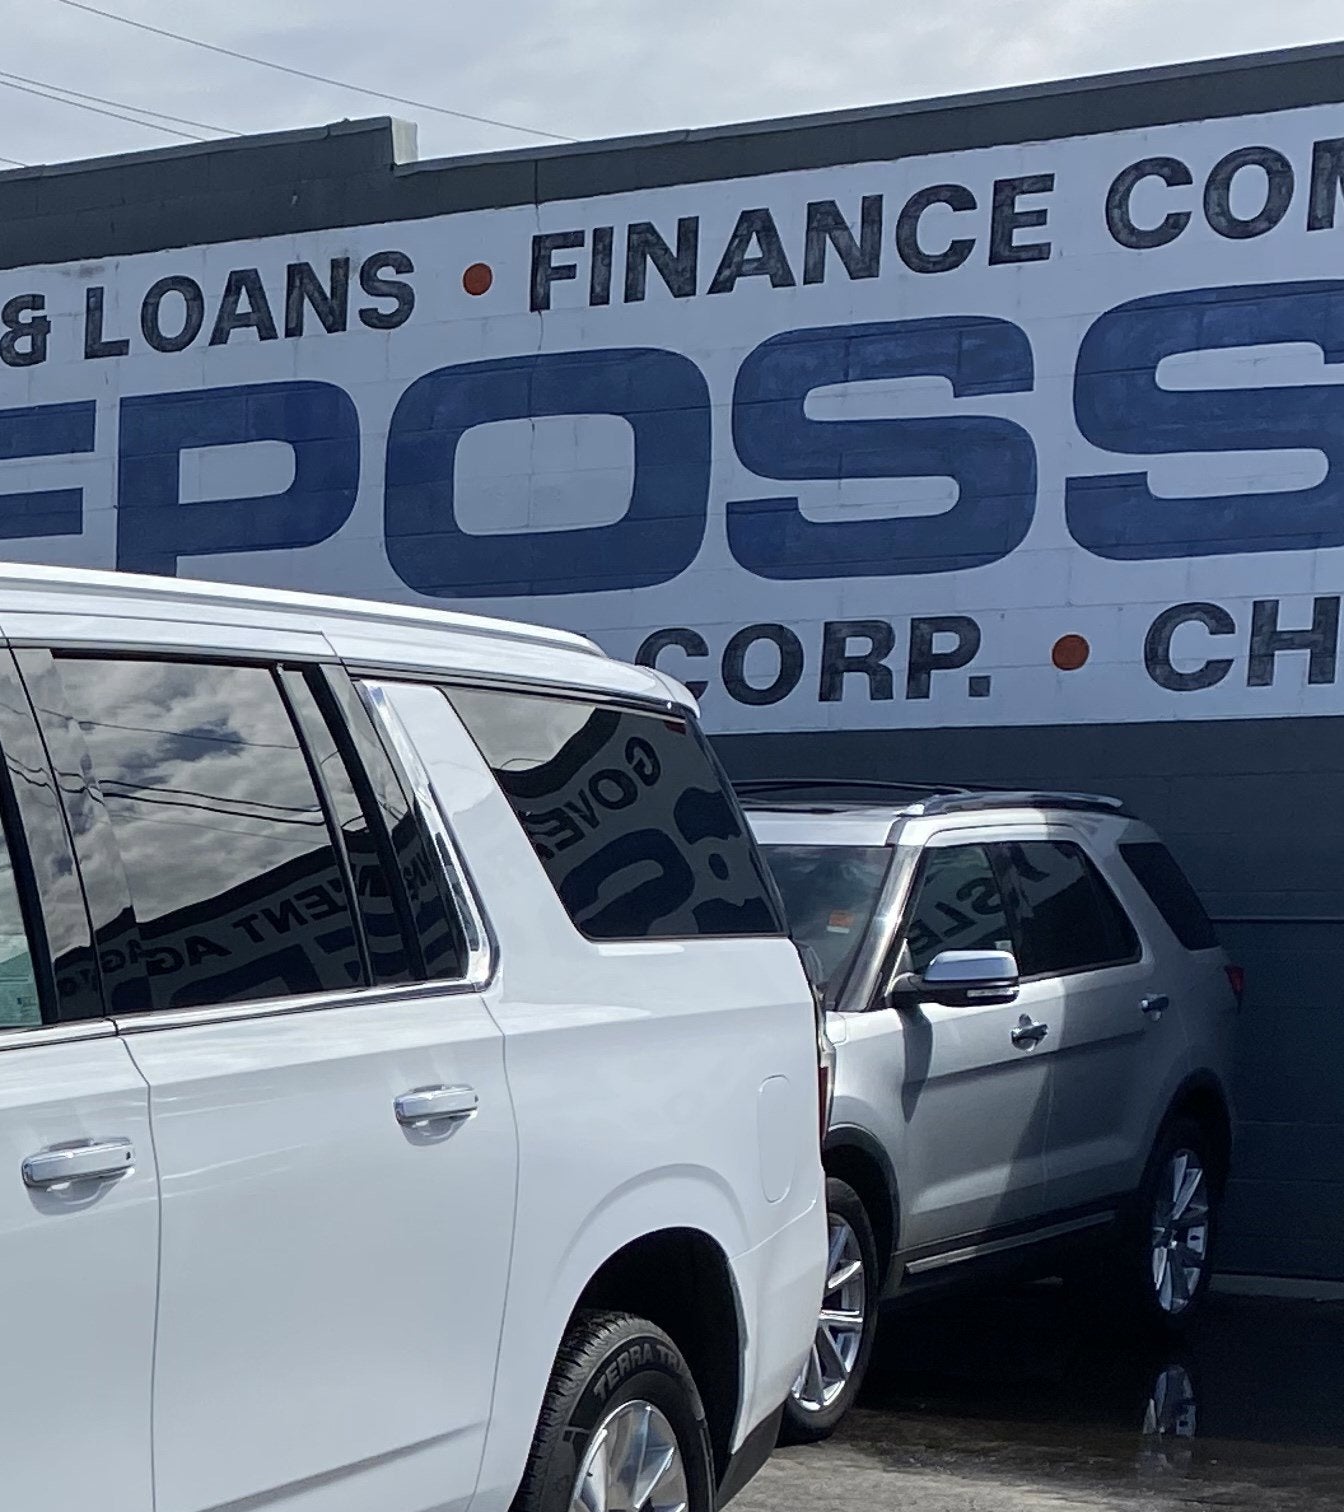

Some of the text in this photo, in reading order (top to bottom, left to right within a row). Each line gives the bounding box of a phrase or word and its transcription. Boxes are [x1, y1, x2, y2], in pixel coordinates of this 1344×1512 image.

[83, 250, 416, 360] LOANS
[528, 173, 1056, 313] FINANCE
[593, 1343, 653, 1402] TERRA
